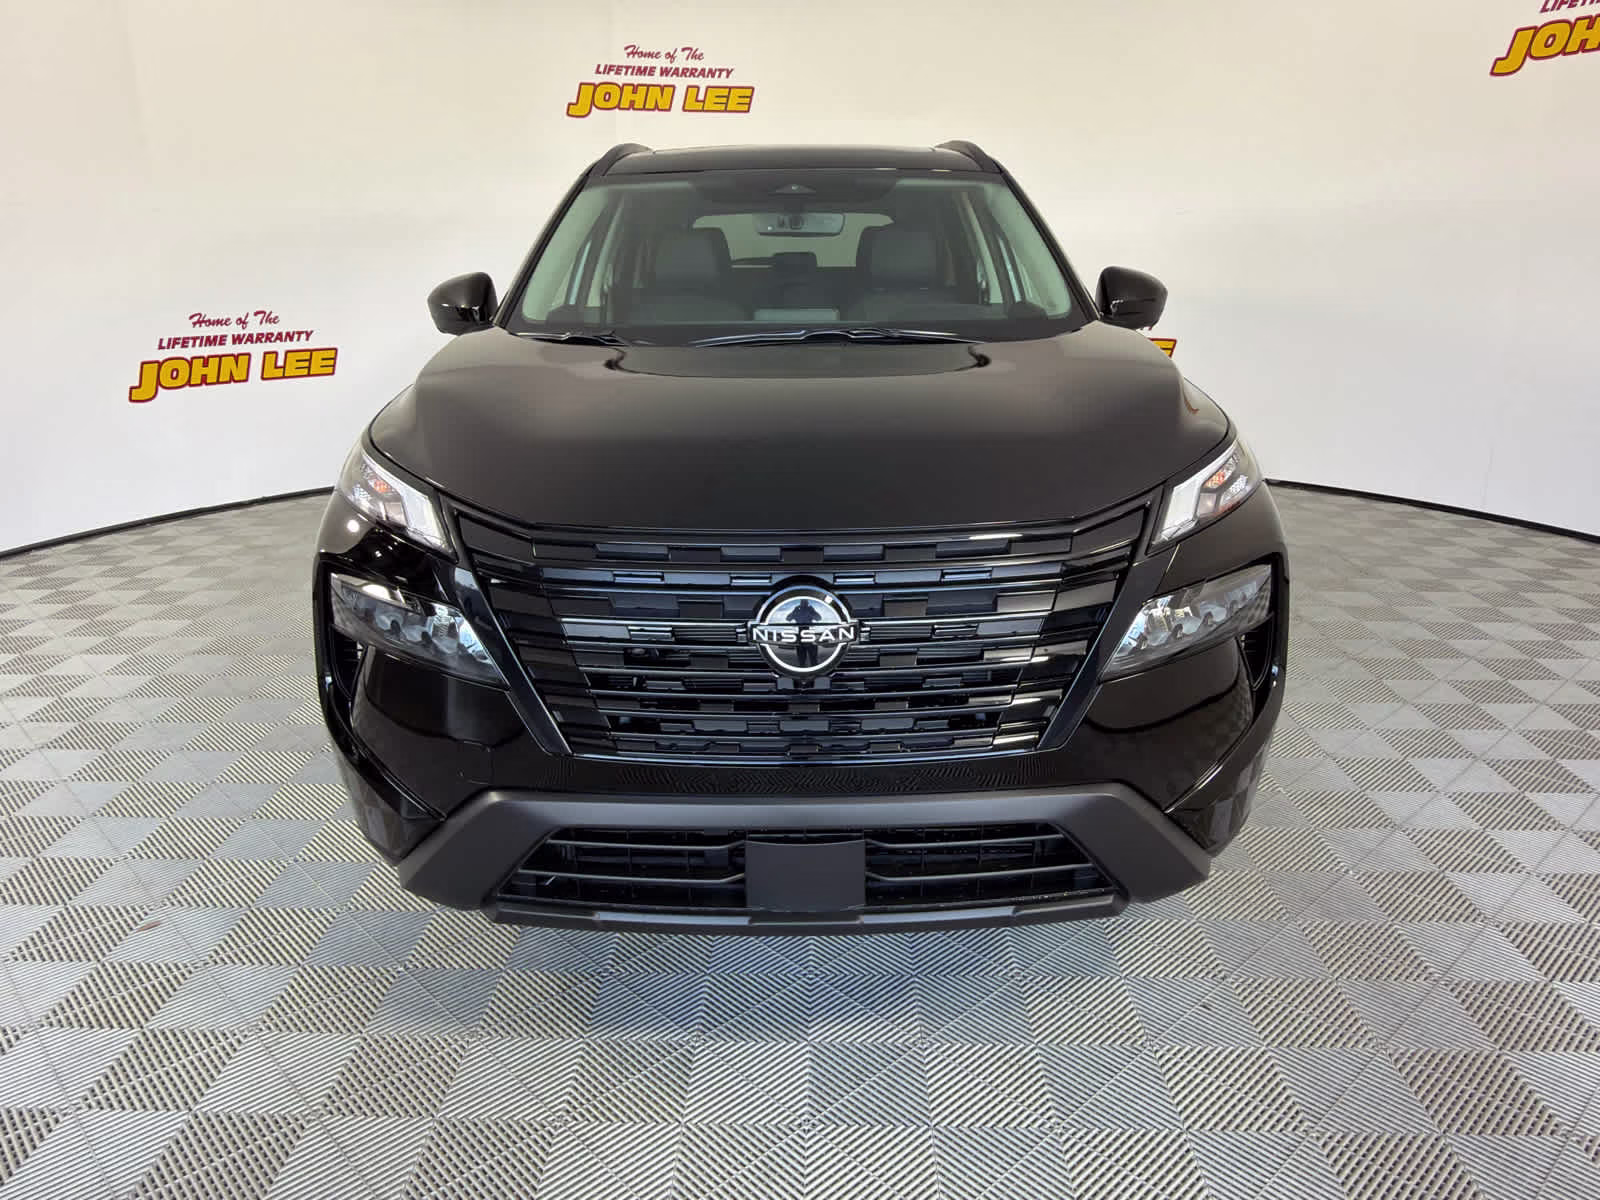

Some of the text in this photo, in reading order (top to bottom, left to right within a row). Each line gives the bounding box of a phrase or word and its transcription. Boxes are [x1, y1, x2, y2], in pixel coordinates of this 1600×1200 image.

[624, 44, 704, 63] Home of The
[1490, 14, 1600, 76] JOH
[595, 64, 734, 79] LIFETIME WARRANTY
[566, 82, 755, 118] JOHN LEE
[188, 310, 280, 329] Home of The
[158, 330, 314, 350] LIFETIME WARRANTY
[129, 347, 338, 403] JOHN LEE
[752, 626, 855, 643] NISSAN
